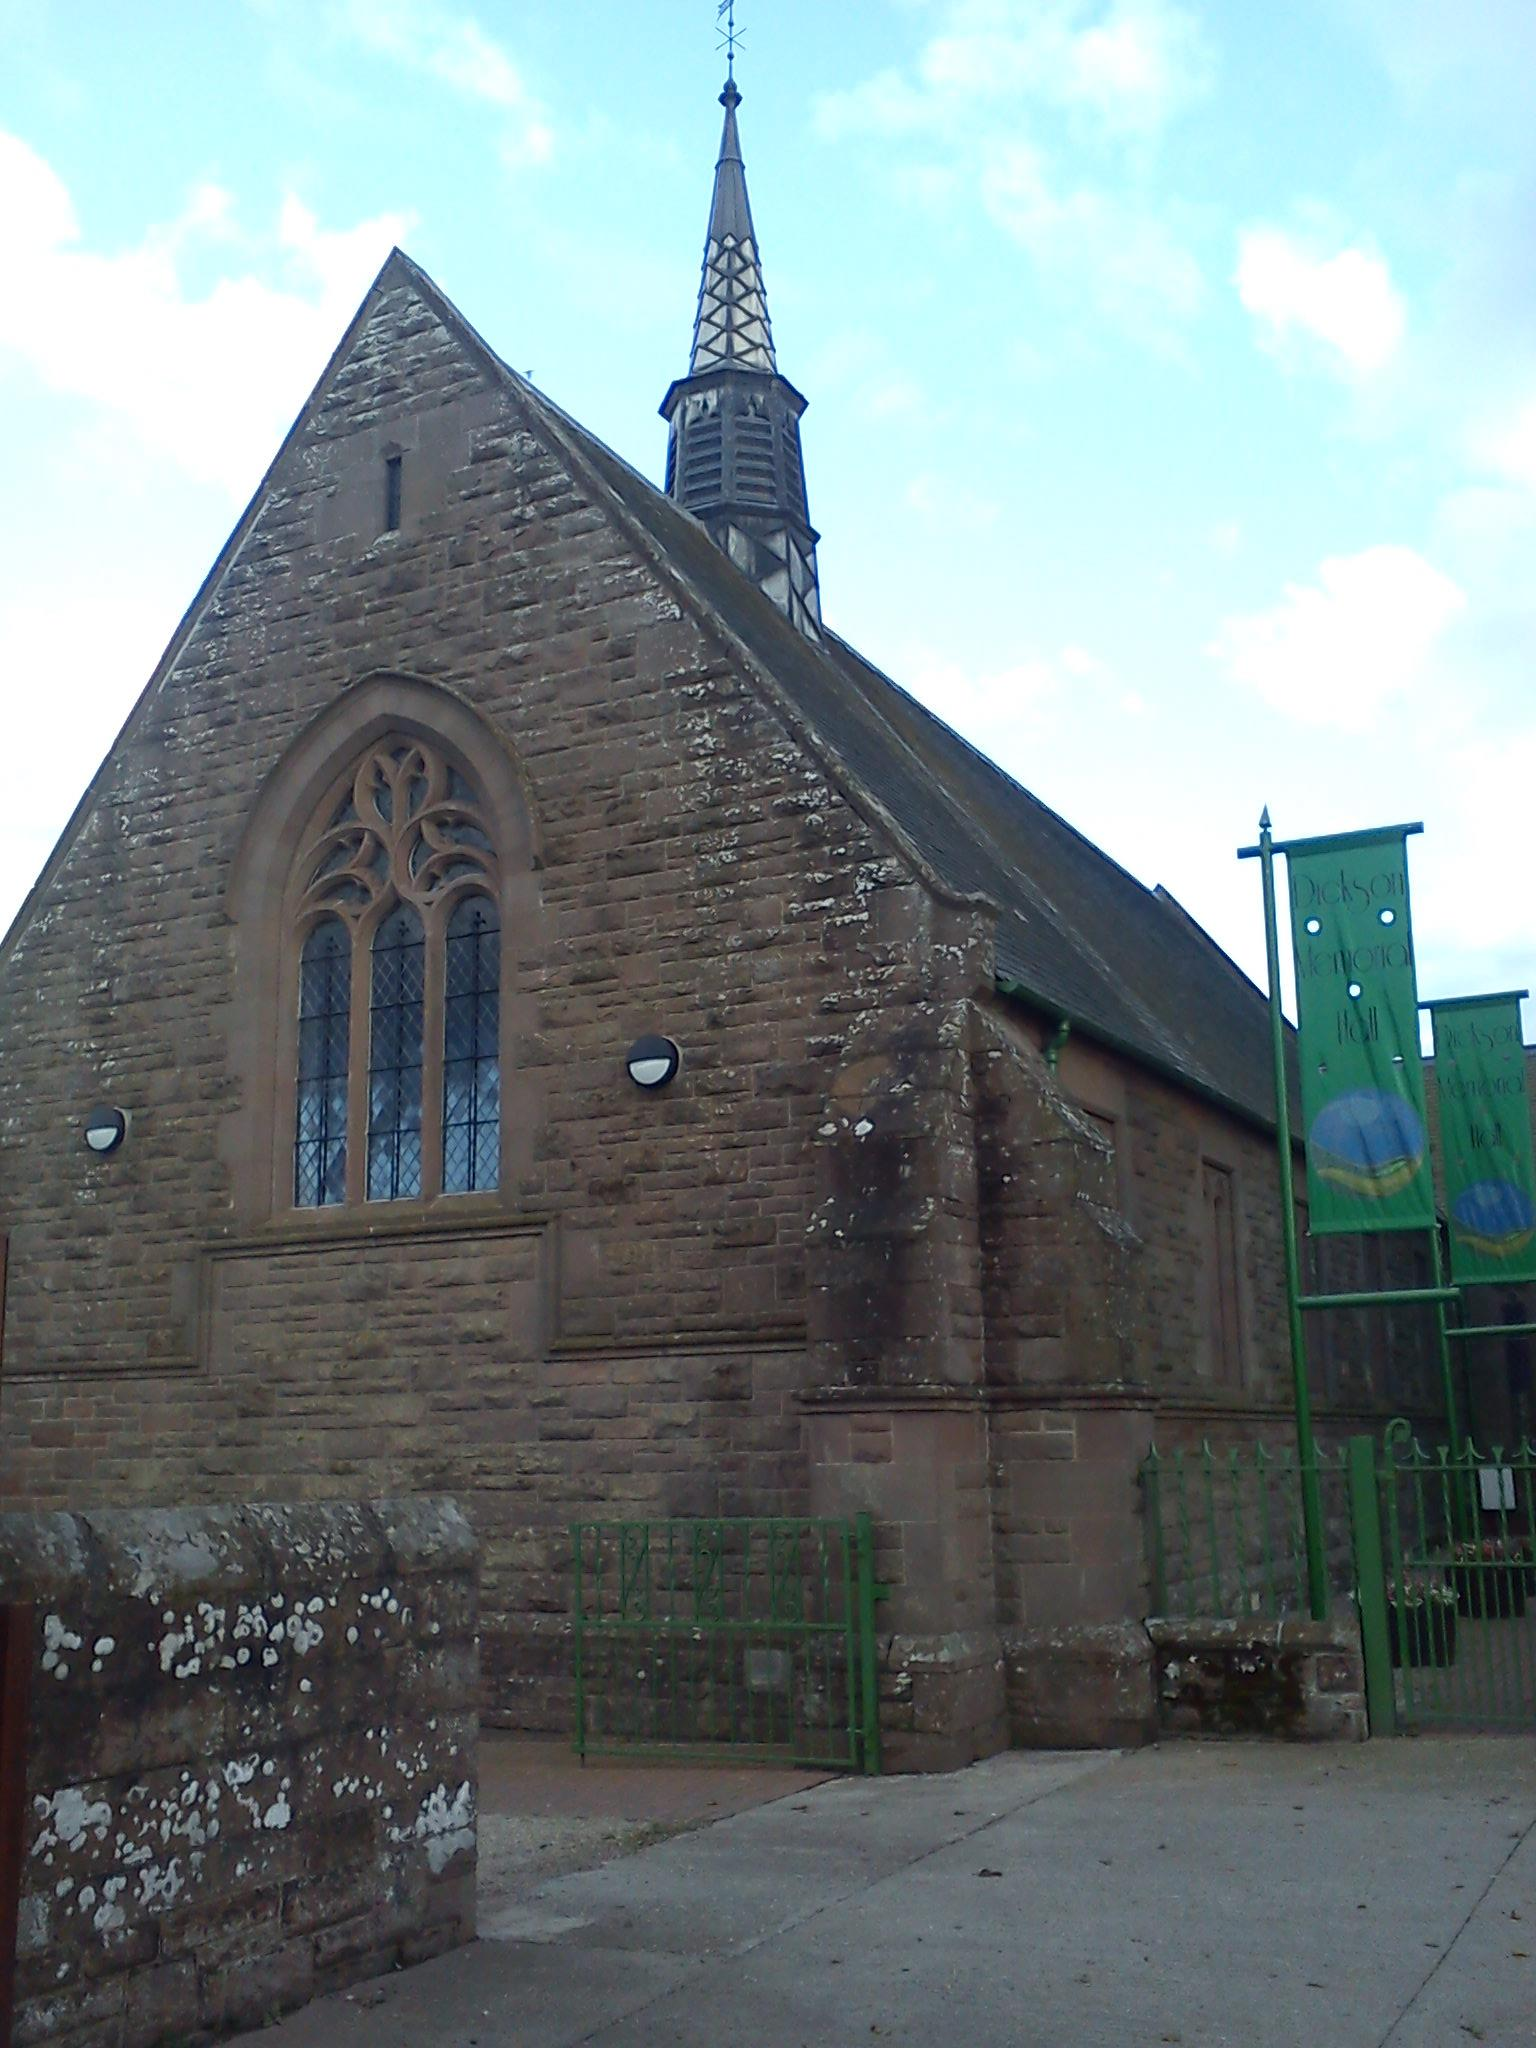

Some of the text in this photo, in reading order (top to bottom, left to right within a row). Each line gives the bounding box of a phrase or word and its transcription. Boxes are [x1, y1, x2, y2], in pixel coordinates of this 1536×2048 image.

[1293, 868, 1405, 914] Dickson
[1336, 1005, 1379, 1046] Hall
[1469, 1120, 1502, 1151] Hall
